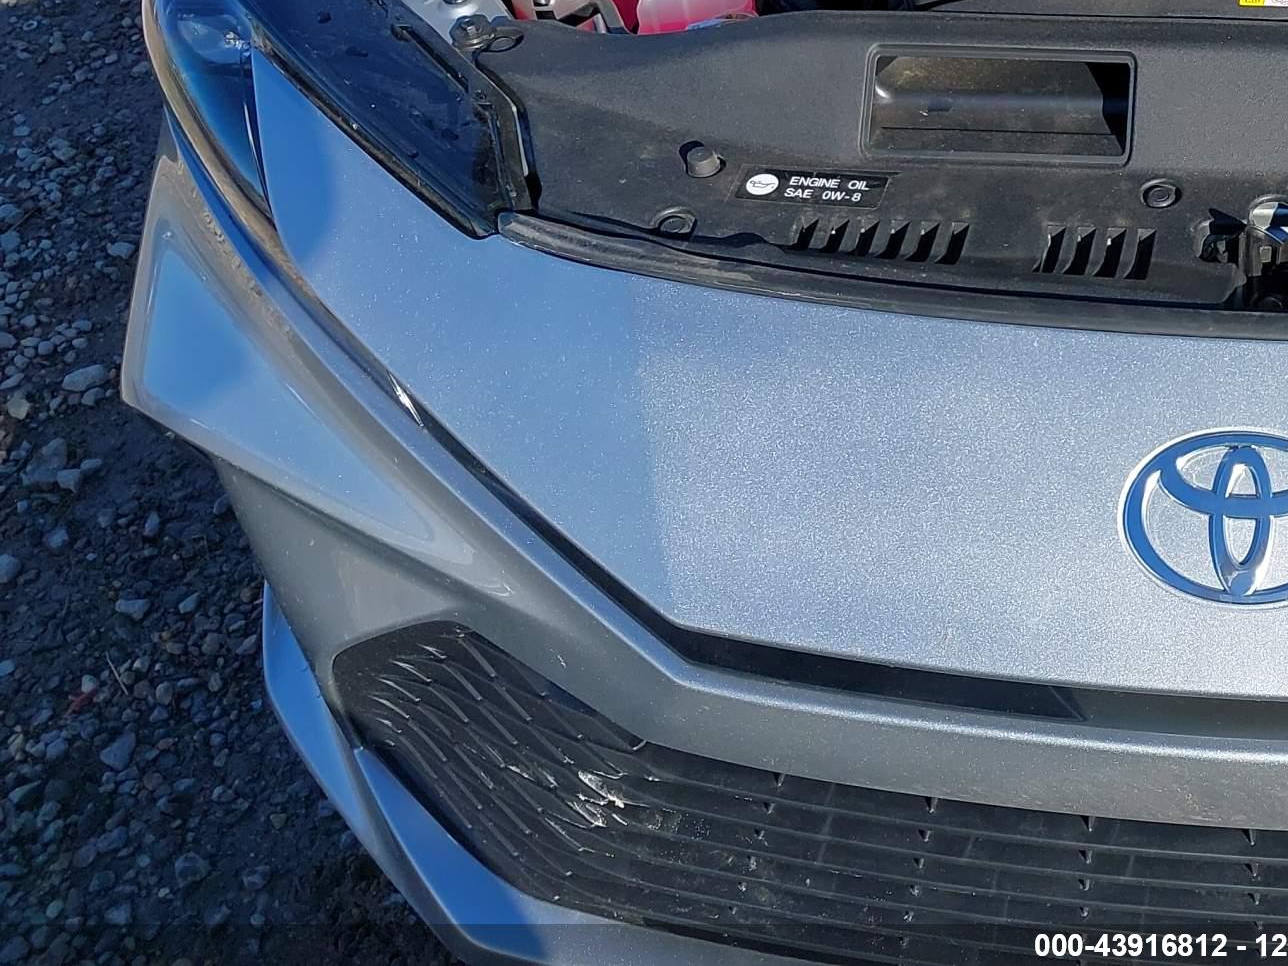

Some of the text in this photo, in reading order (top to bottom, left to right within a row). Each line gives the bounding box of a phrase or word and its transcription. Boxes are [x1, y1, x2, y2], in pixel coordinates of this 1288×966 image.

[789, 176, 870, 191] ENGINE OIL
[784, 188, 862, 202] SAE 0W-8
